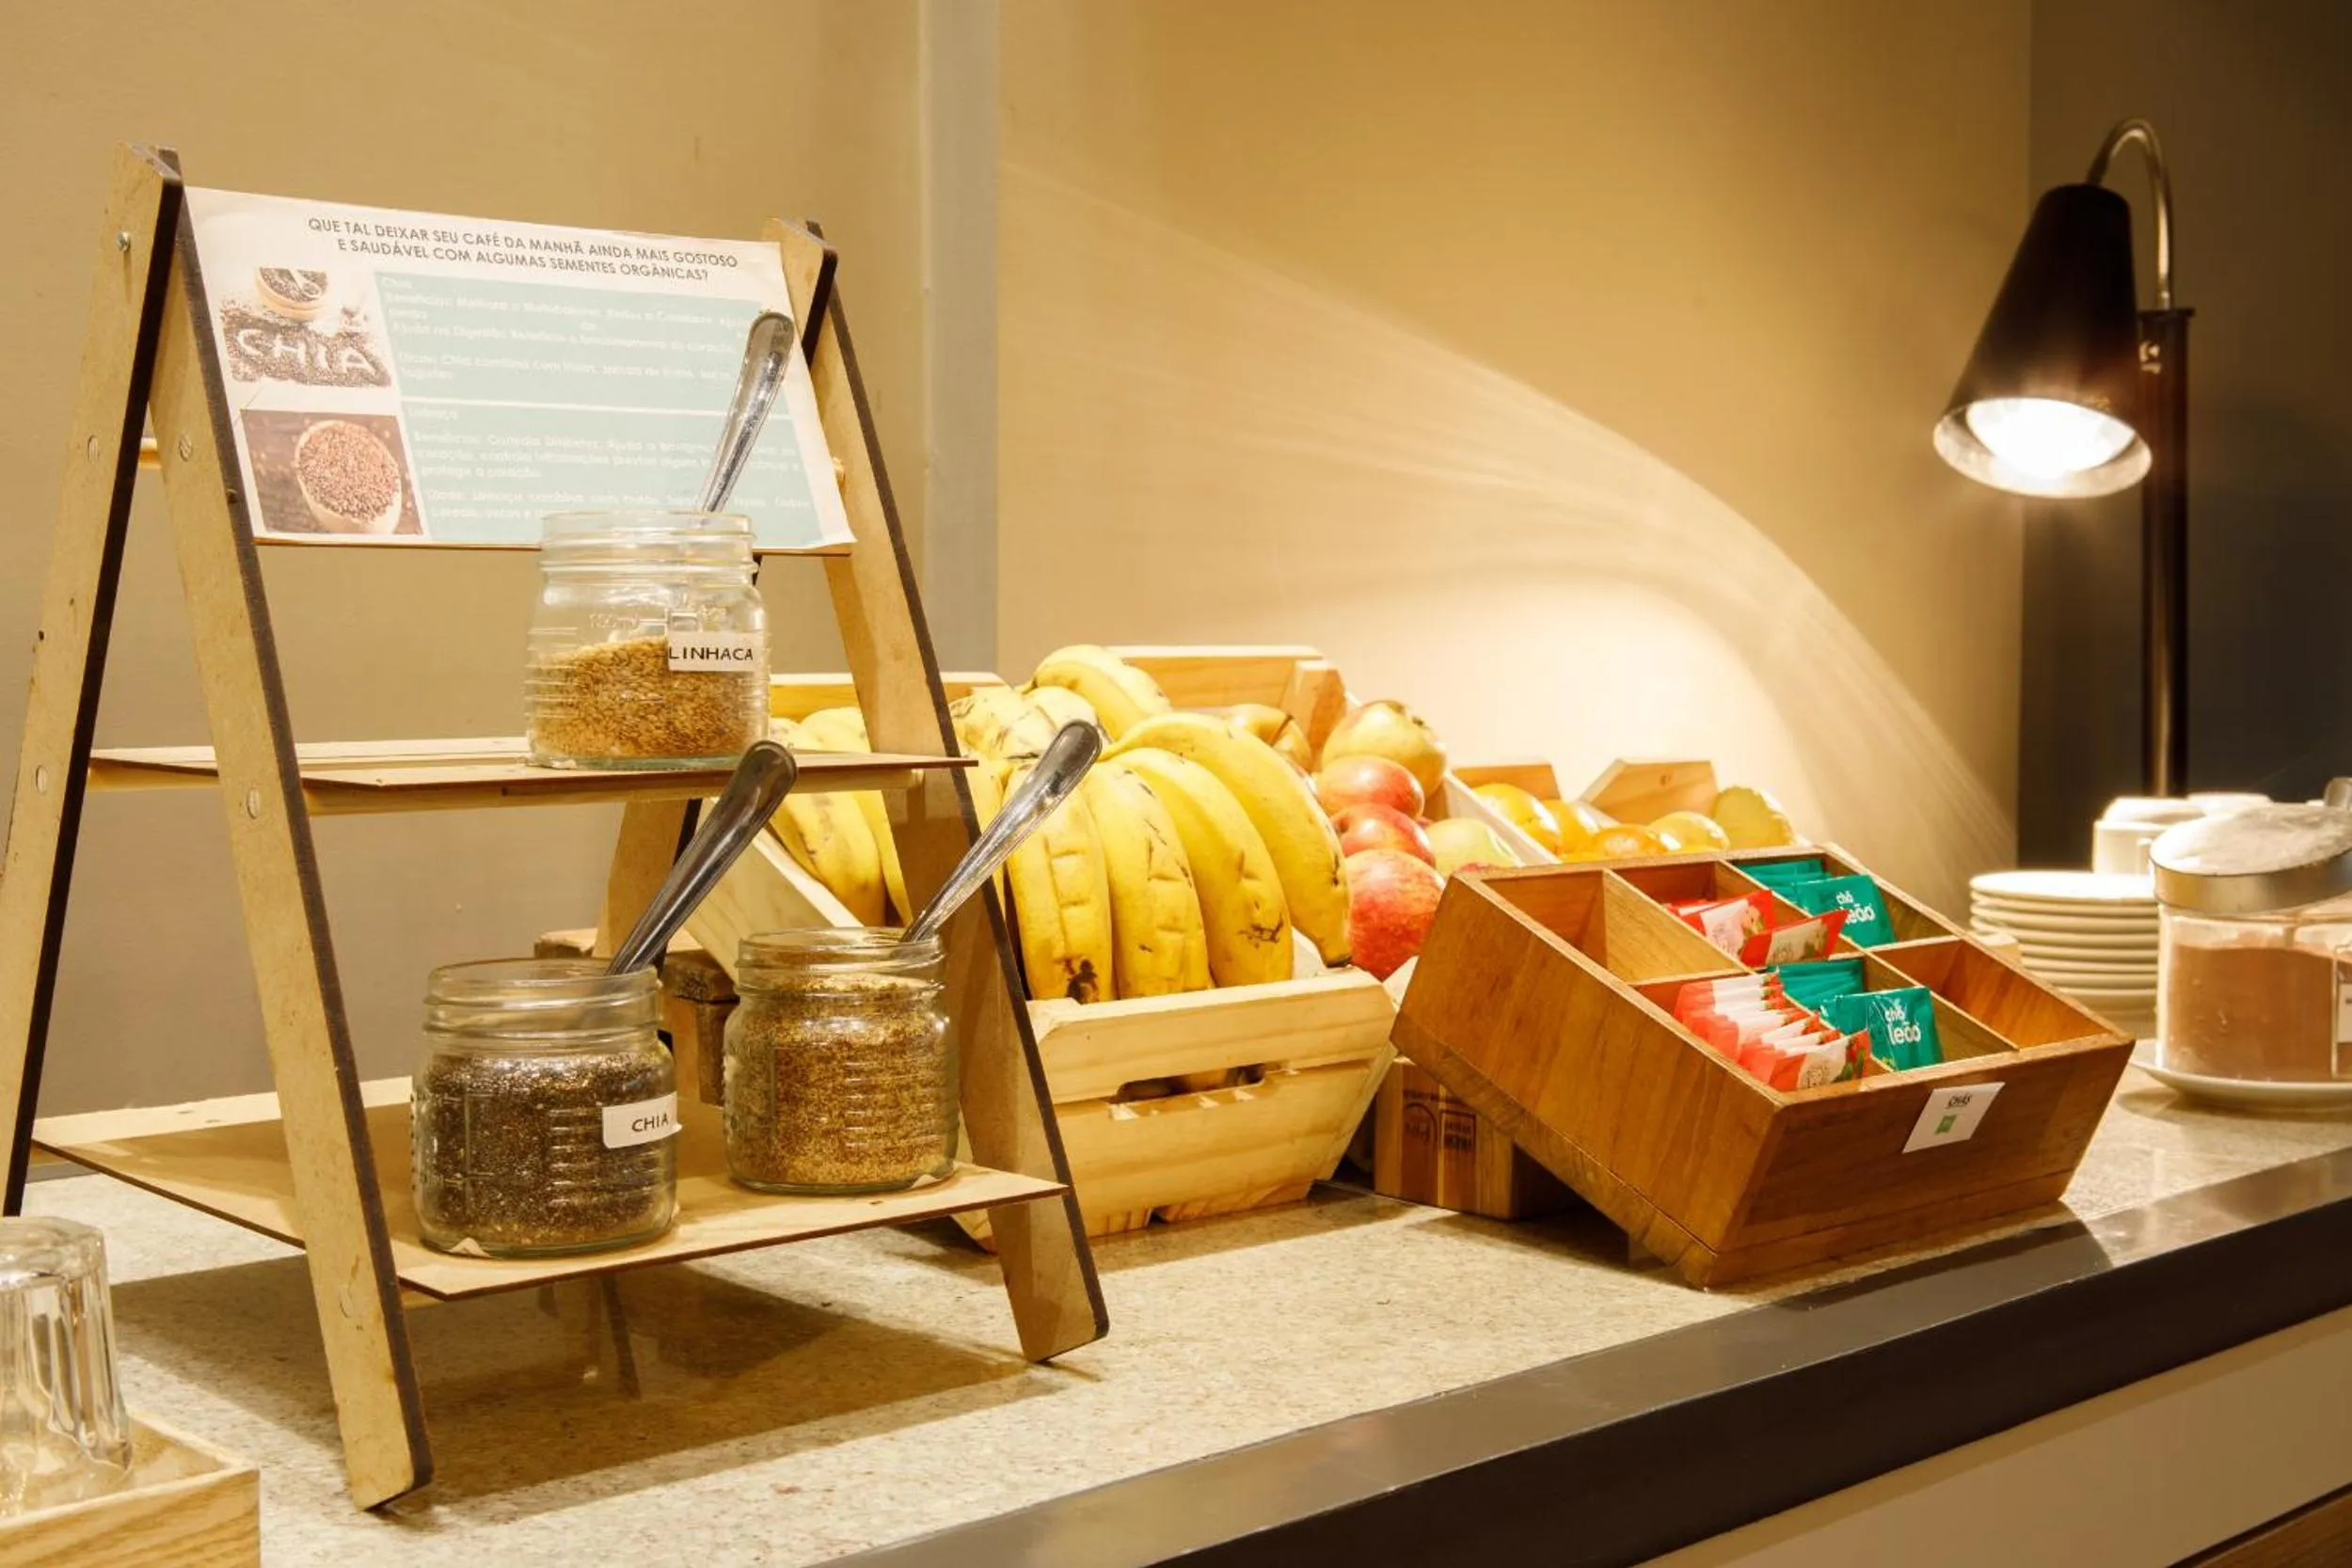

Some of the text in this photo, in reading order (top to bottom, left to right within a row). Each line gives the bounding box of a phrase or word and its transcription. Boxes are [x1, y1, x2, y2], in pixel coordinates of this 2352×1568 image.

[309, 217, 739, 268] QUE TAL DEIXAR SEU CAFÉ DA MANHÃ AINDA MAIS GOSTOSO
[338, 238, 347, 251] E
[351, 239, 430, 260] SAUDÁVEL
[433, 246, 472, 262] COM
[476, 250, 547, 268] ALGUMAS
[549, 257, 617, 275] SEMENTES
[237, 329, 377, 376] CHIA
[669, 646, 754, 661] LINHACA
[1840, 903, 1876, 925] eão
[631, 1113, 670, 1132] CHIA
